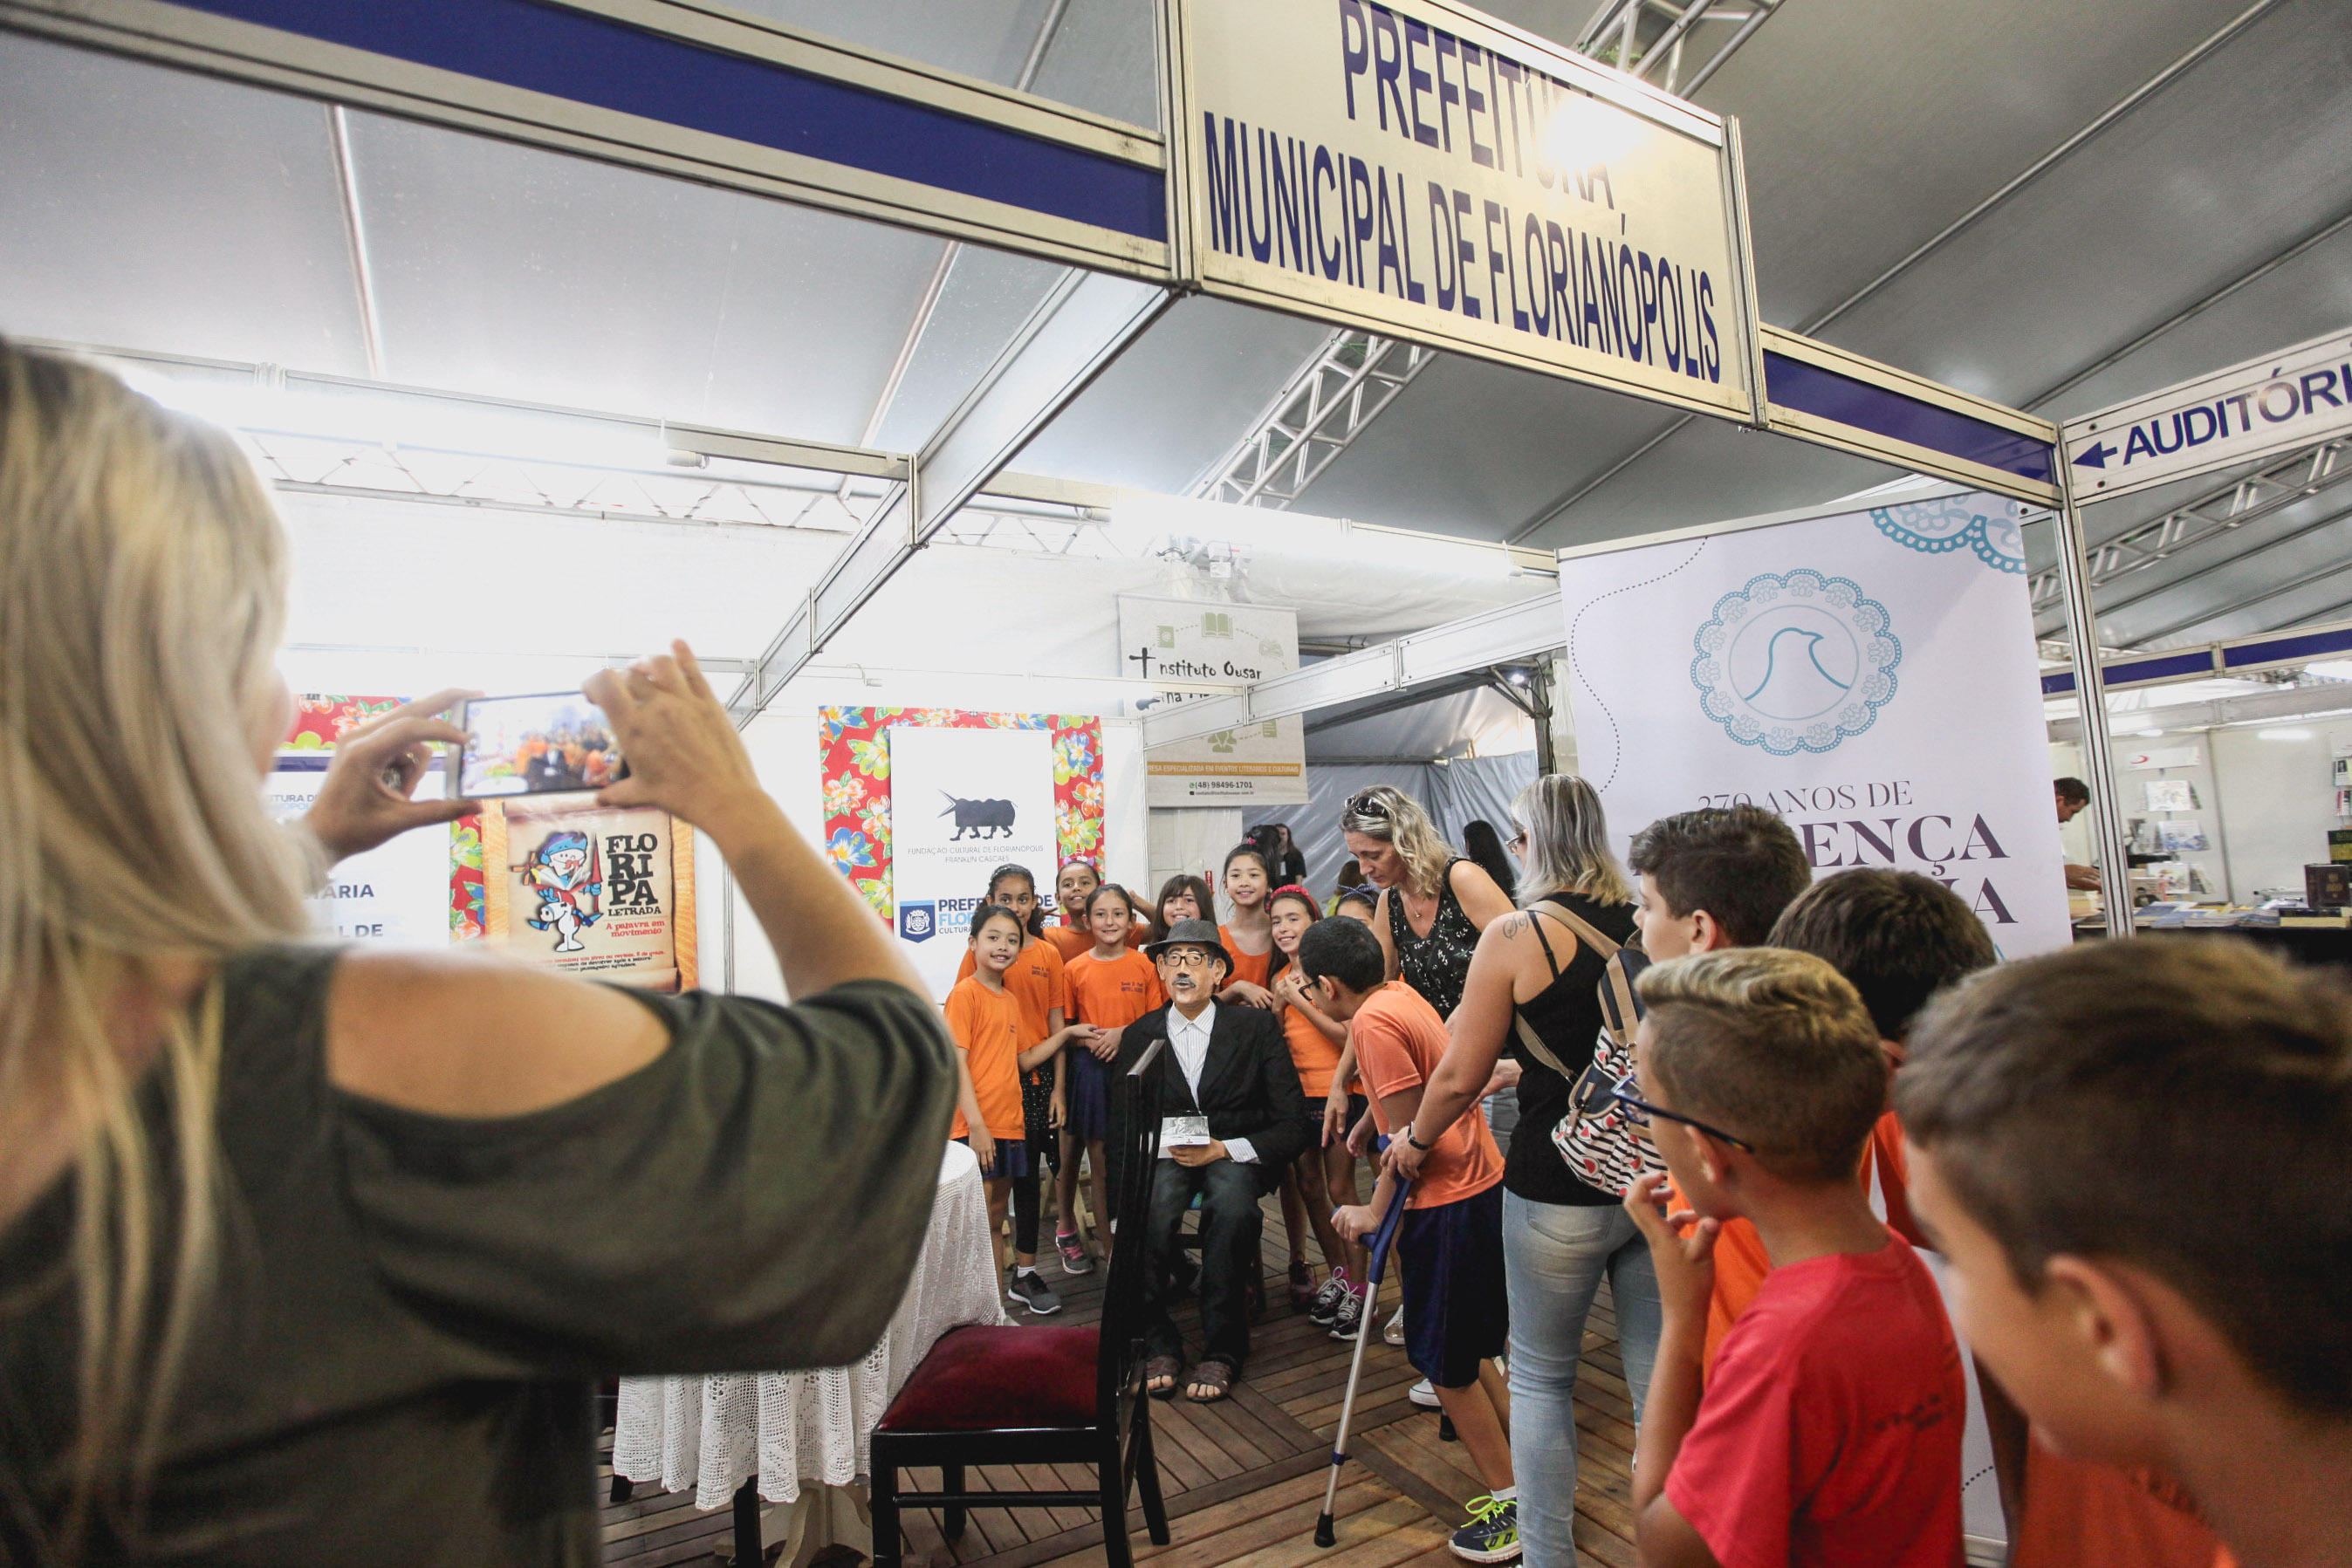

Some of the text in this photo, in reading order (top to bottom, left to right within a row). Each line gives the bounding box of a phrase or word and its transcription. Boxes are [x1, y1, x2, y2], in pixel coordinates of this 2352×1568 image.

[1341, 0, 1615, 211] PREFEITUA
[1203, 111, 1721, 385] MUNICIPAL DE FLORIANÓPOLIS
[2123, 363, 2352, 465] AUDITÓRI
[1224, 661, 1262, 680] Ousar
[1195, 781, 1210, 790] (48)
[1765, 784, 1856, 814] ANOS
[1868, 780, 1913, 808] DE
[606, 832, 658, 854] FLO
[993, 844, 1044, 852] FLORIANÓPOLIS
[1800, 811, 2011, 876] ENÇA
[607, 852, 654, 881] RI
[313, 884, 374, 900] ARIA
[607, 879, 658, 906] PA
[607, 906, 662, 916] LETRADA
[354, 923, 384, 938] DE
[611, 928, 662, 937] movimento
[614, 921, 650, 931] palavra
